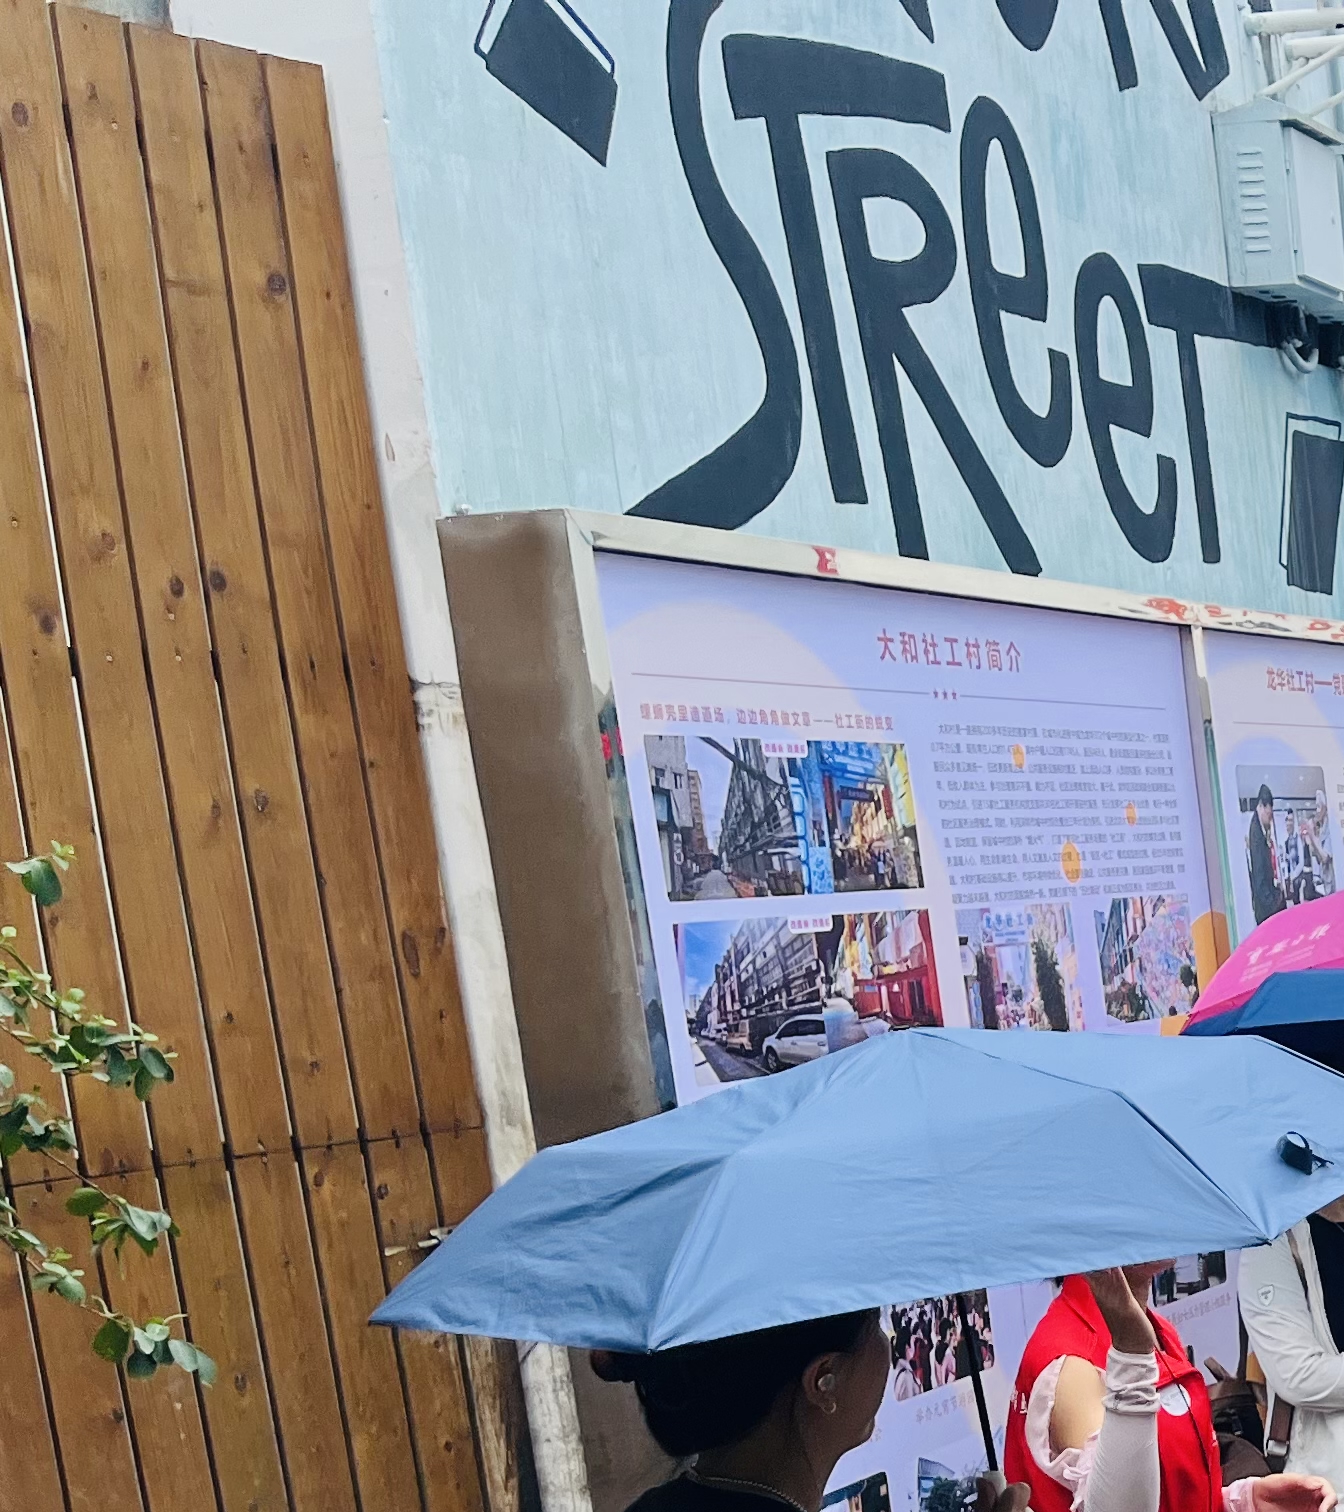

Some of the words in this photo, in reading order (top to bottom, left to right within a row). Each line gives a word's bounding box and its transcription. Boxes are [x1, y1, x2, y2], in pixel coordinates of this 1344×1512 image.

[877, 628, 1022, 673] 大和社工村简介
